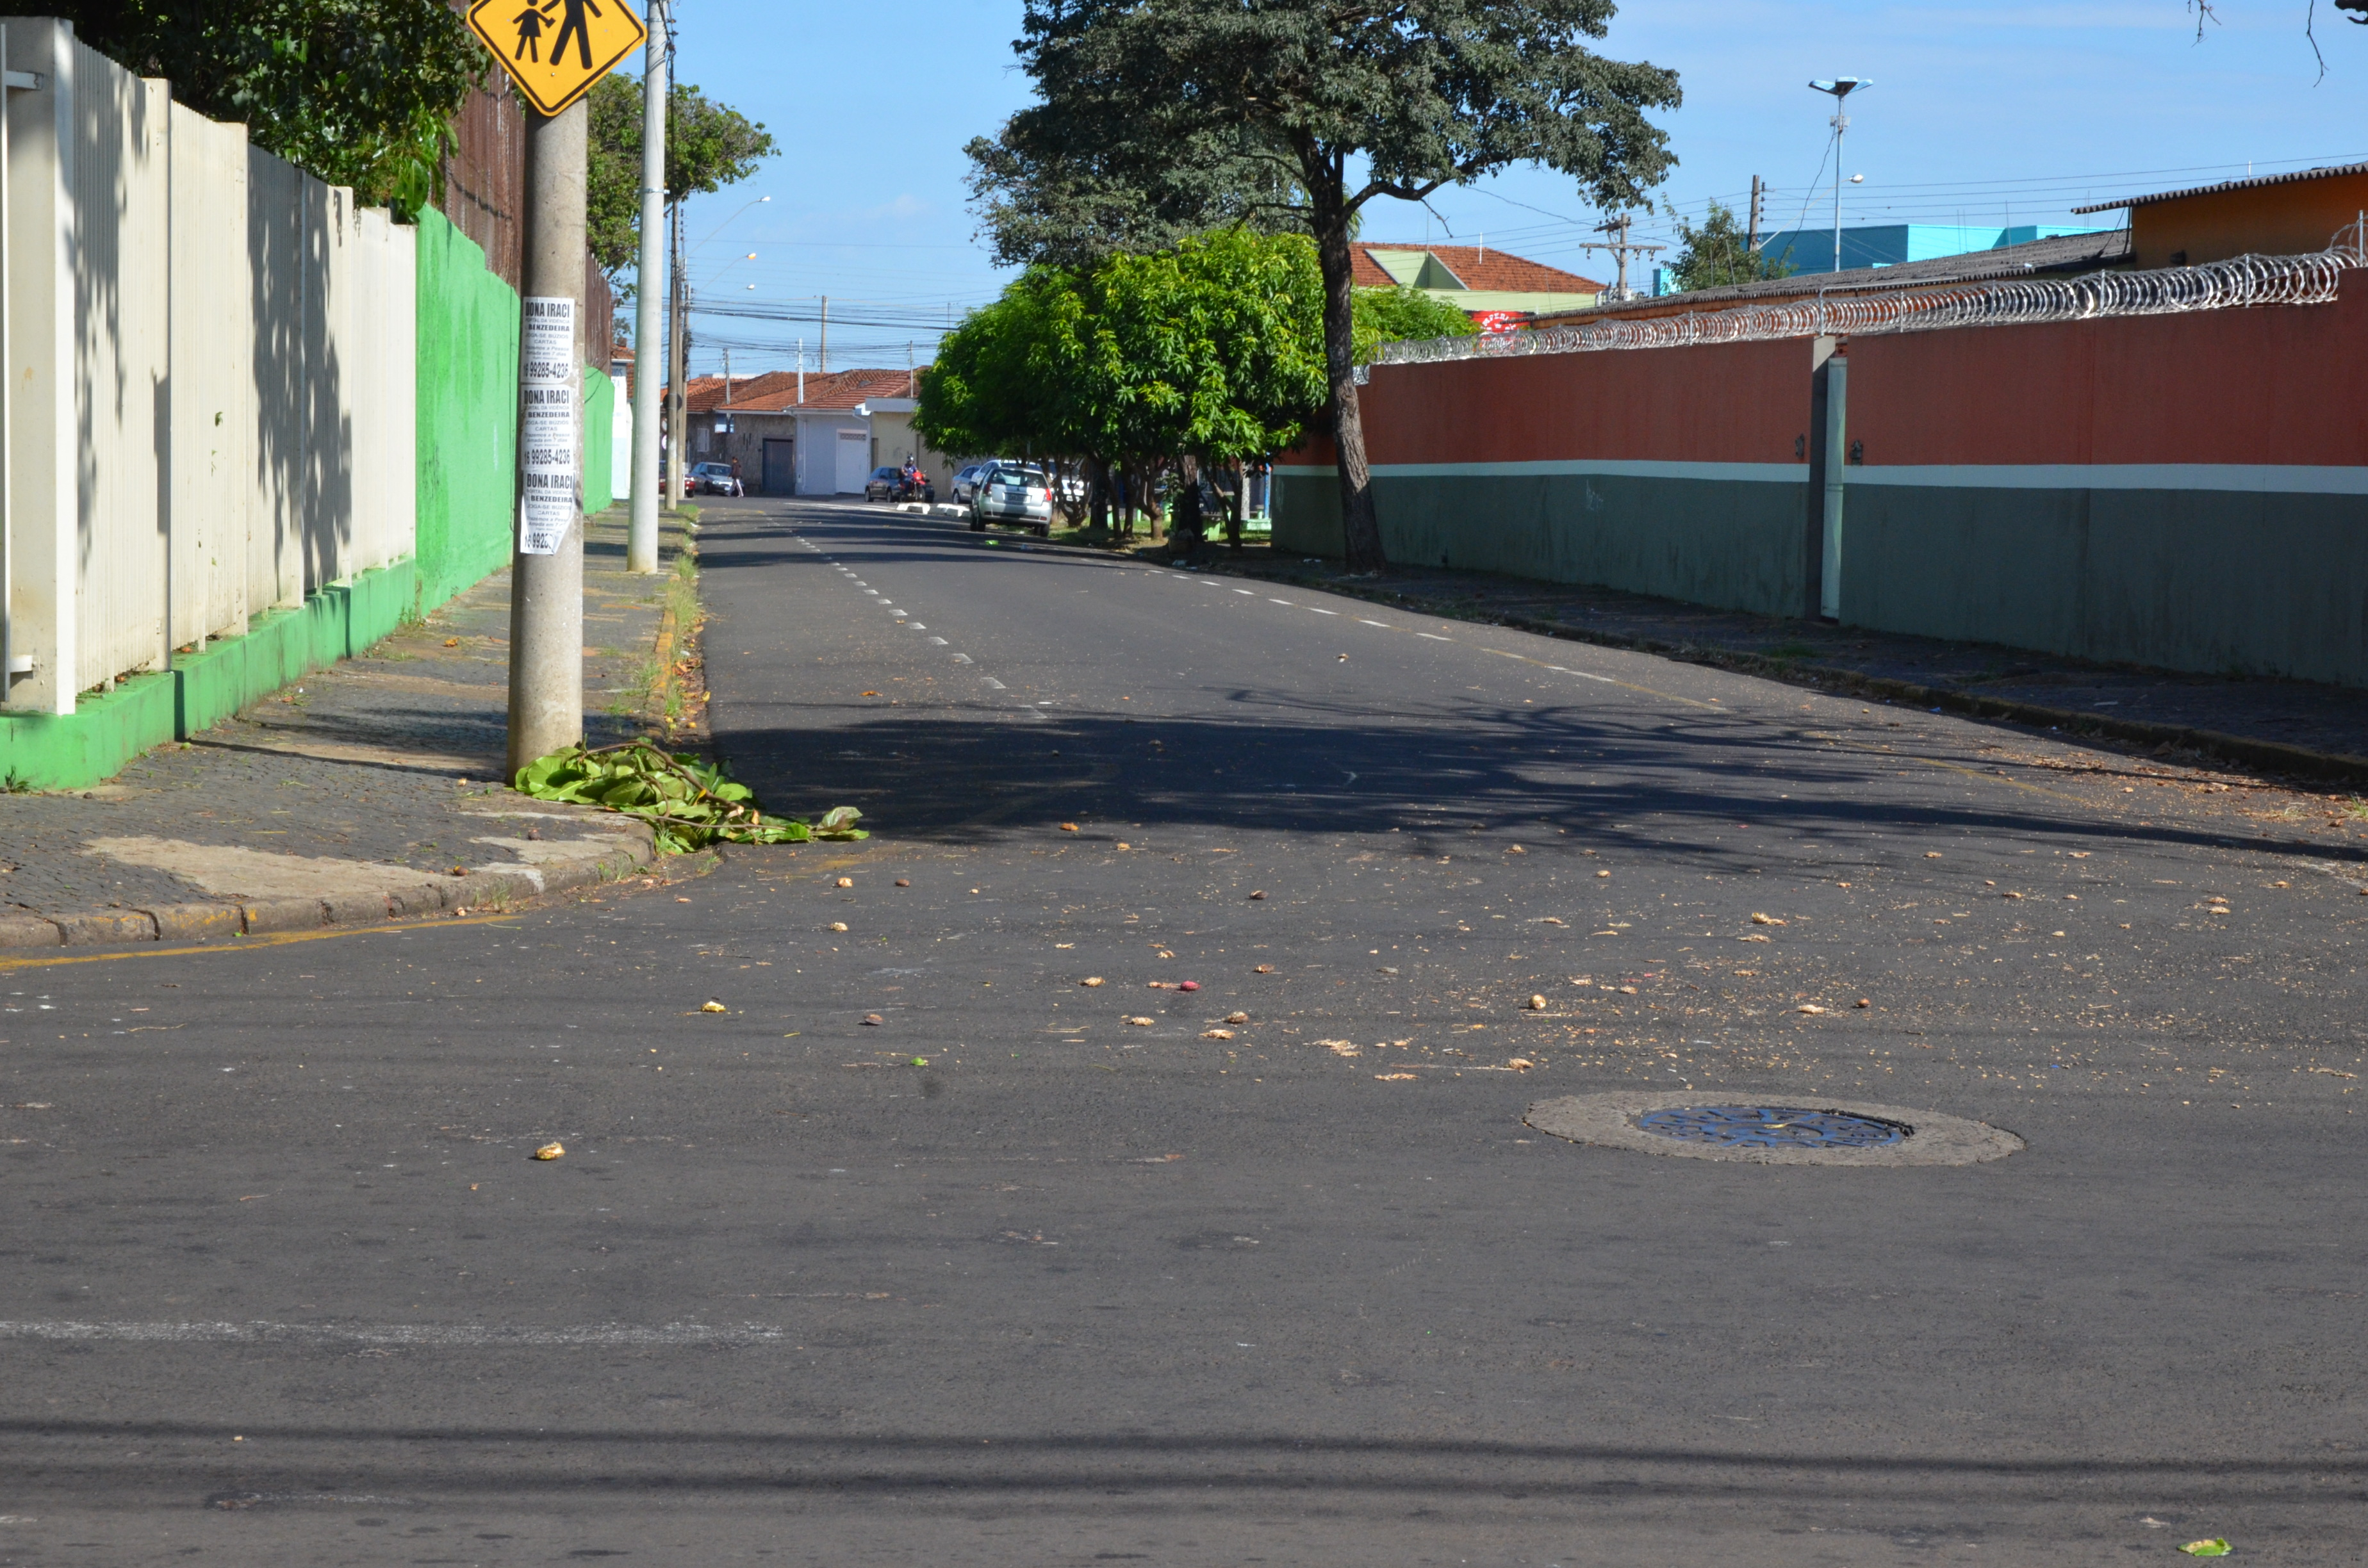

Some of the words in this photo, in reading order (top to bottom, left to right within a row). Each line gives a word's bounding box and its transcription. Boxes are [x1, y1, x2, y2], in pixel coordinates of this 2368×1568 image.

[525, 302, 545, 317] DONA
[547, 303, 570, 318] IRACI
[523, 363, 529, 377] 16
[530, 361, 568, 378] 99285-4236
[524, 389, 545, 404] DONA
[547, 389, 569, 404] IRACI
[524, 451, 530, 465] 16
[532, 449, 570, 465] 99285-4236
[551, 475, 572, 489] IRACI
[525, 534, 531, 548] 16
